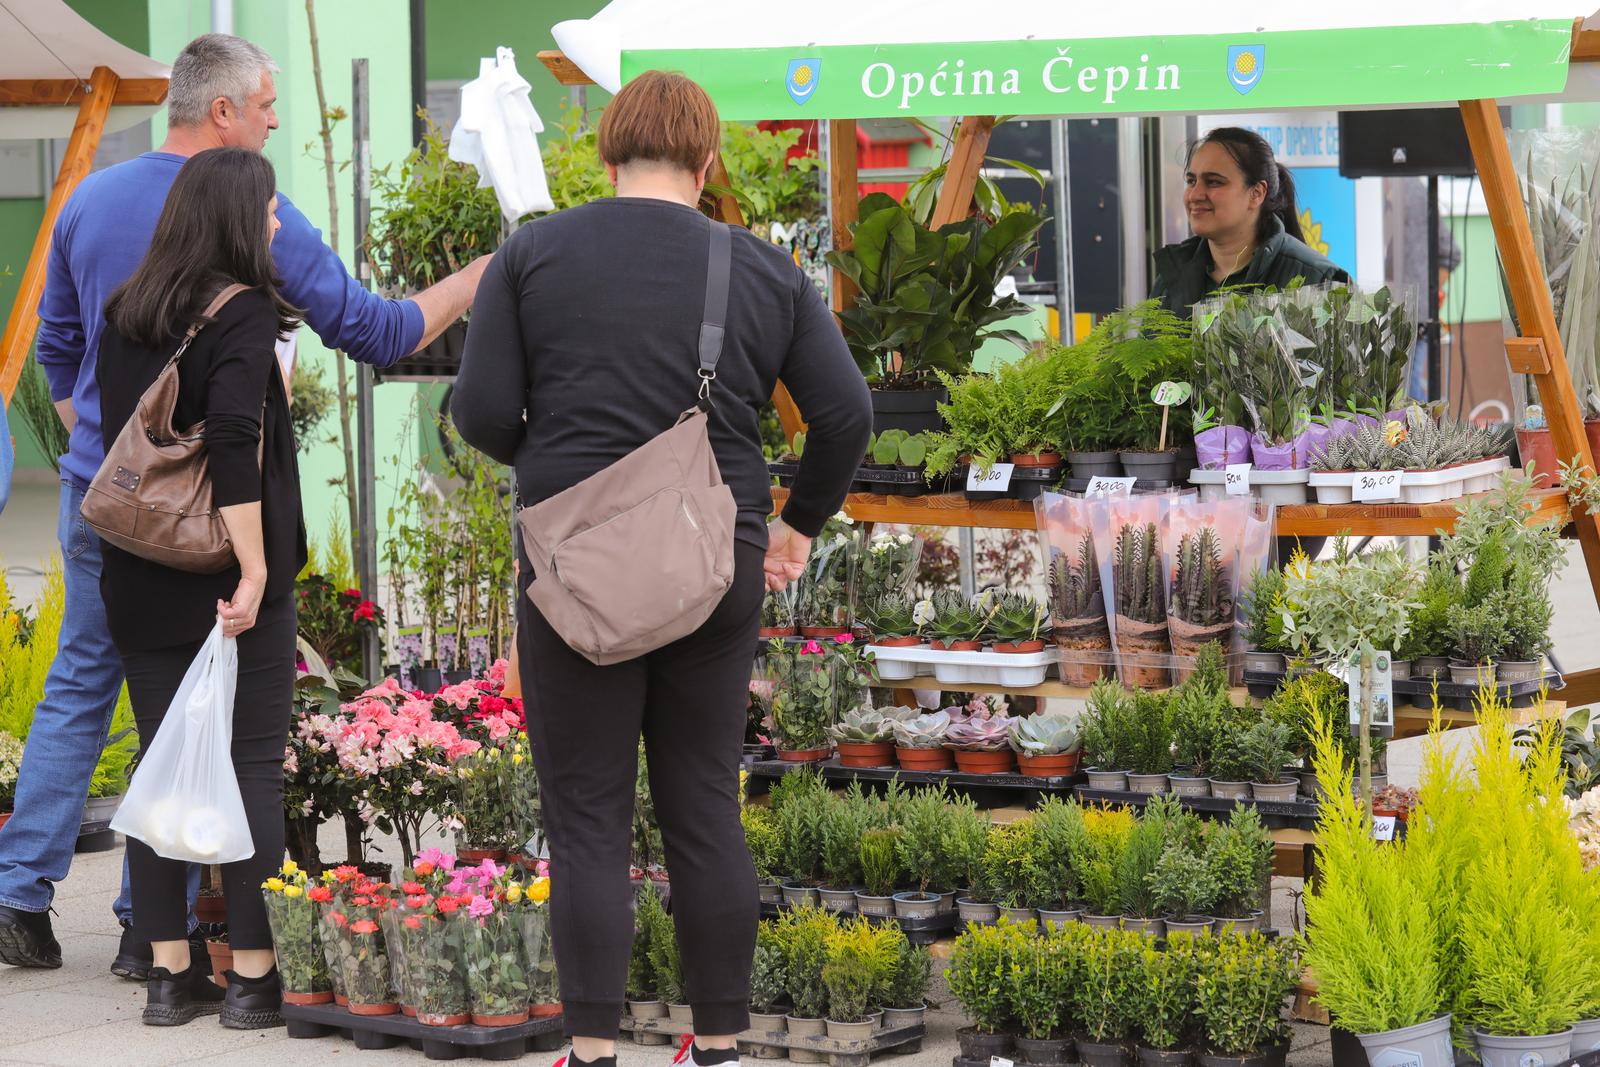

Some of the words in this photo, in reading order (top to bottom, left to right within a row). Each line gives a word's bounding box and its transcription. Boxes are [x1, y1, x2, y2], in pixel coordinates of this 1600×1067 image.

[861, 59, 1021, 109] Općina
[1042, 46, 1181, 104] Čepin
[1360, 475, 1396, 490] 30,00
